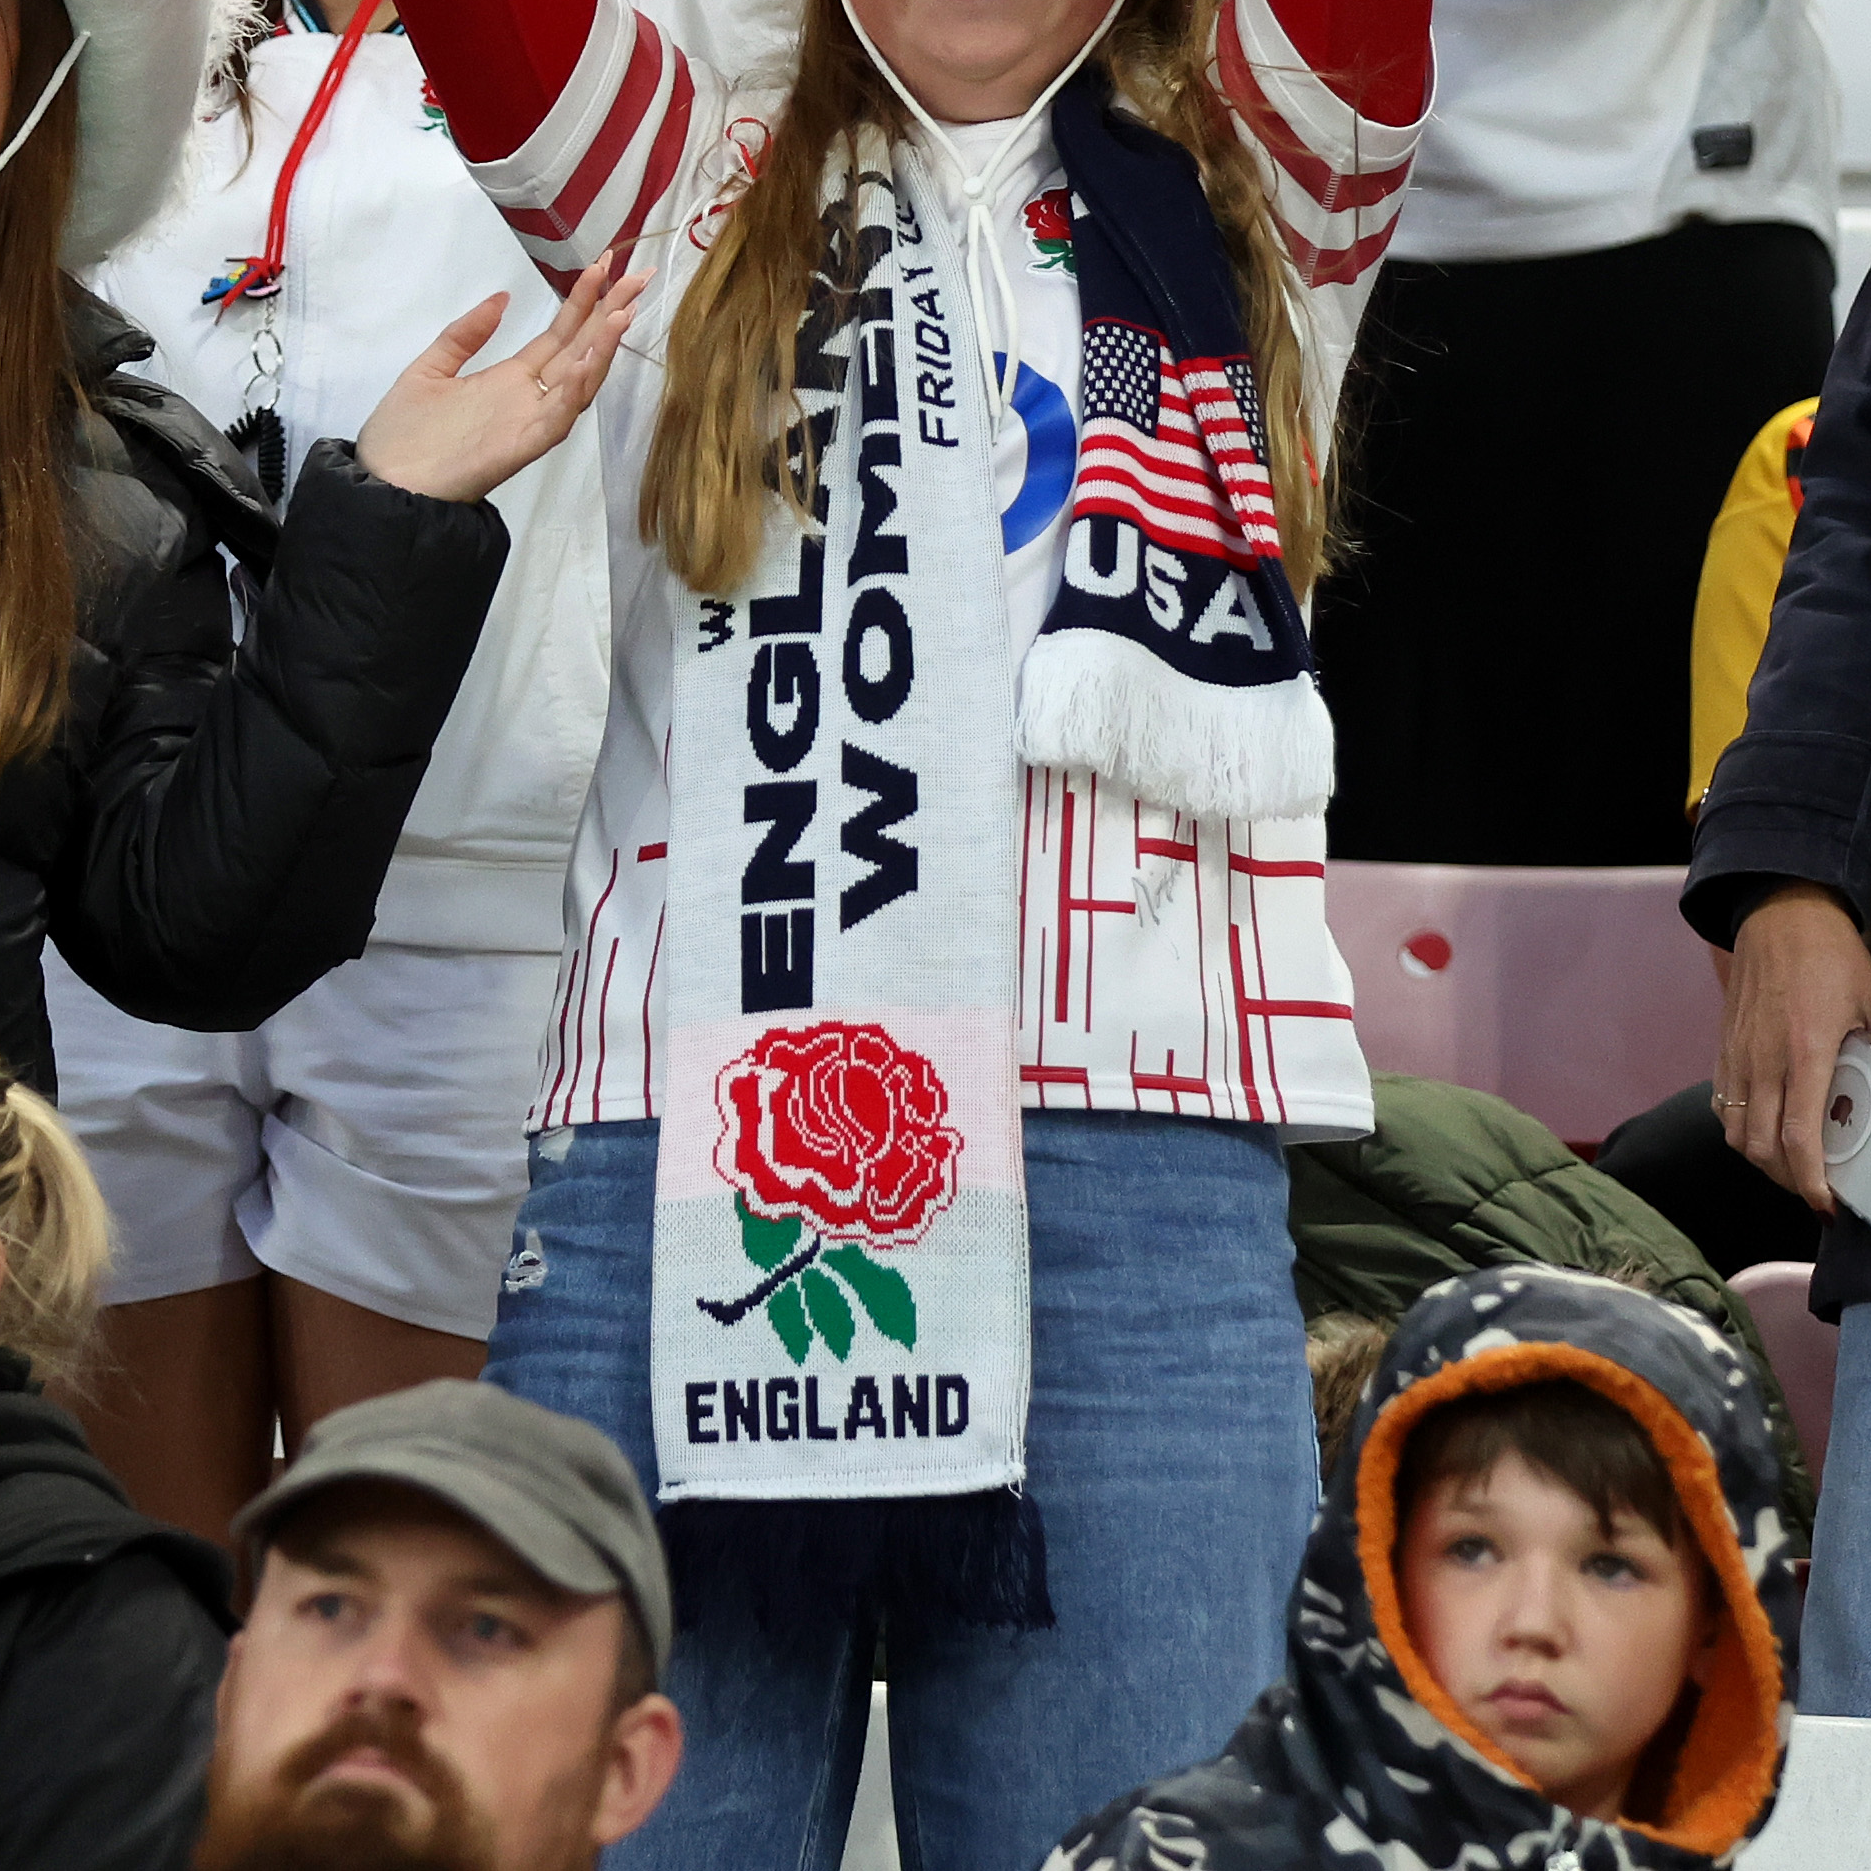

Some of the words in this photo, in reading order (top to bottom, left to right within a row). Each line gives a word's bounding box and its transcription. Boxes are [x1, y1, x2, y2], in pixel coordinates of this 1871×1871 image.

[900, 263, 959, 448] FRIDAY
[1063, 517, 1274, 651] USA
[684, 1373, 970, 1445] ENGLAND
